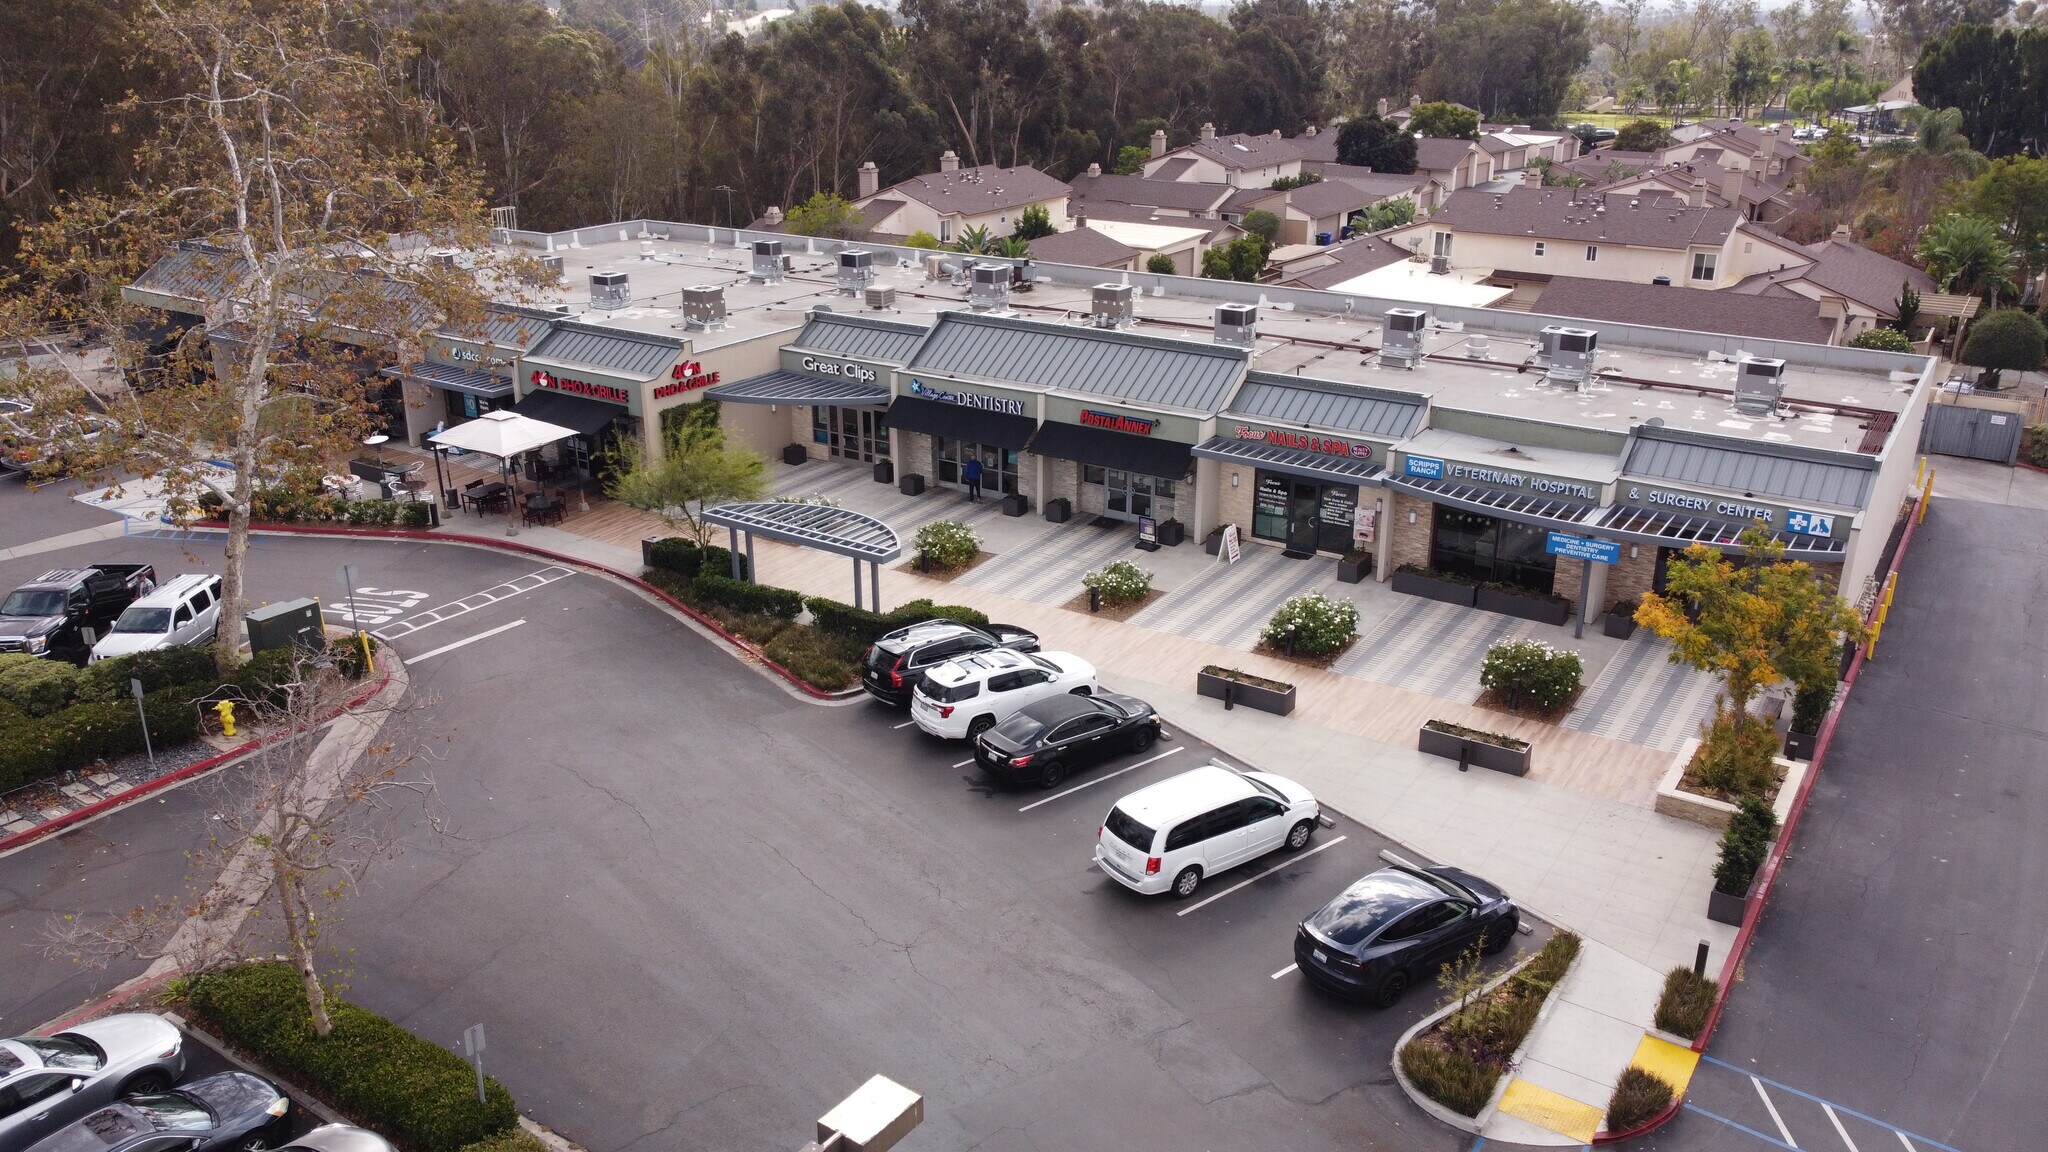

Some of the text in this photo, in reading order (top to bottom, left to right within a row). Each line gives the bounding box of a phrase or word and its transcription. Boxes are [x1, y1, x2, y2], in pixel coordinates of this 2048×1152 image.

[802, 356, 876, 383] Great Clips
[957, 392, 1024, 415] DENTISTRY
[1235, 425, 1350, 456] Focus NAILS & SPA
[1408, 459, 1440, 470] SCRIPPS
[1411, 466, 1437, 476] RANCH
[1446, 463, 1596, 500] VETERINARY HOSPITAL
[1628, 487, 1773, 521] & SURGERY CENTER
[1552, 535, 1615, 551] MEDICINE SURGERY
[1554, 546, 1609, 562] PREVENTIVE CARE
[1566, 544, 1599, 554] DENTISTRY
[320, 586, 430, 624] STOP
